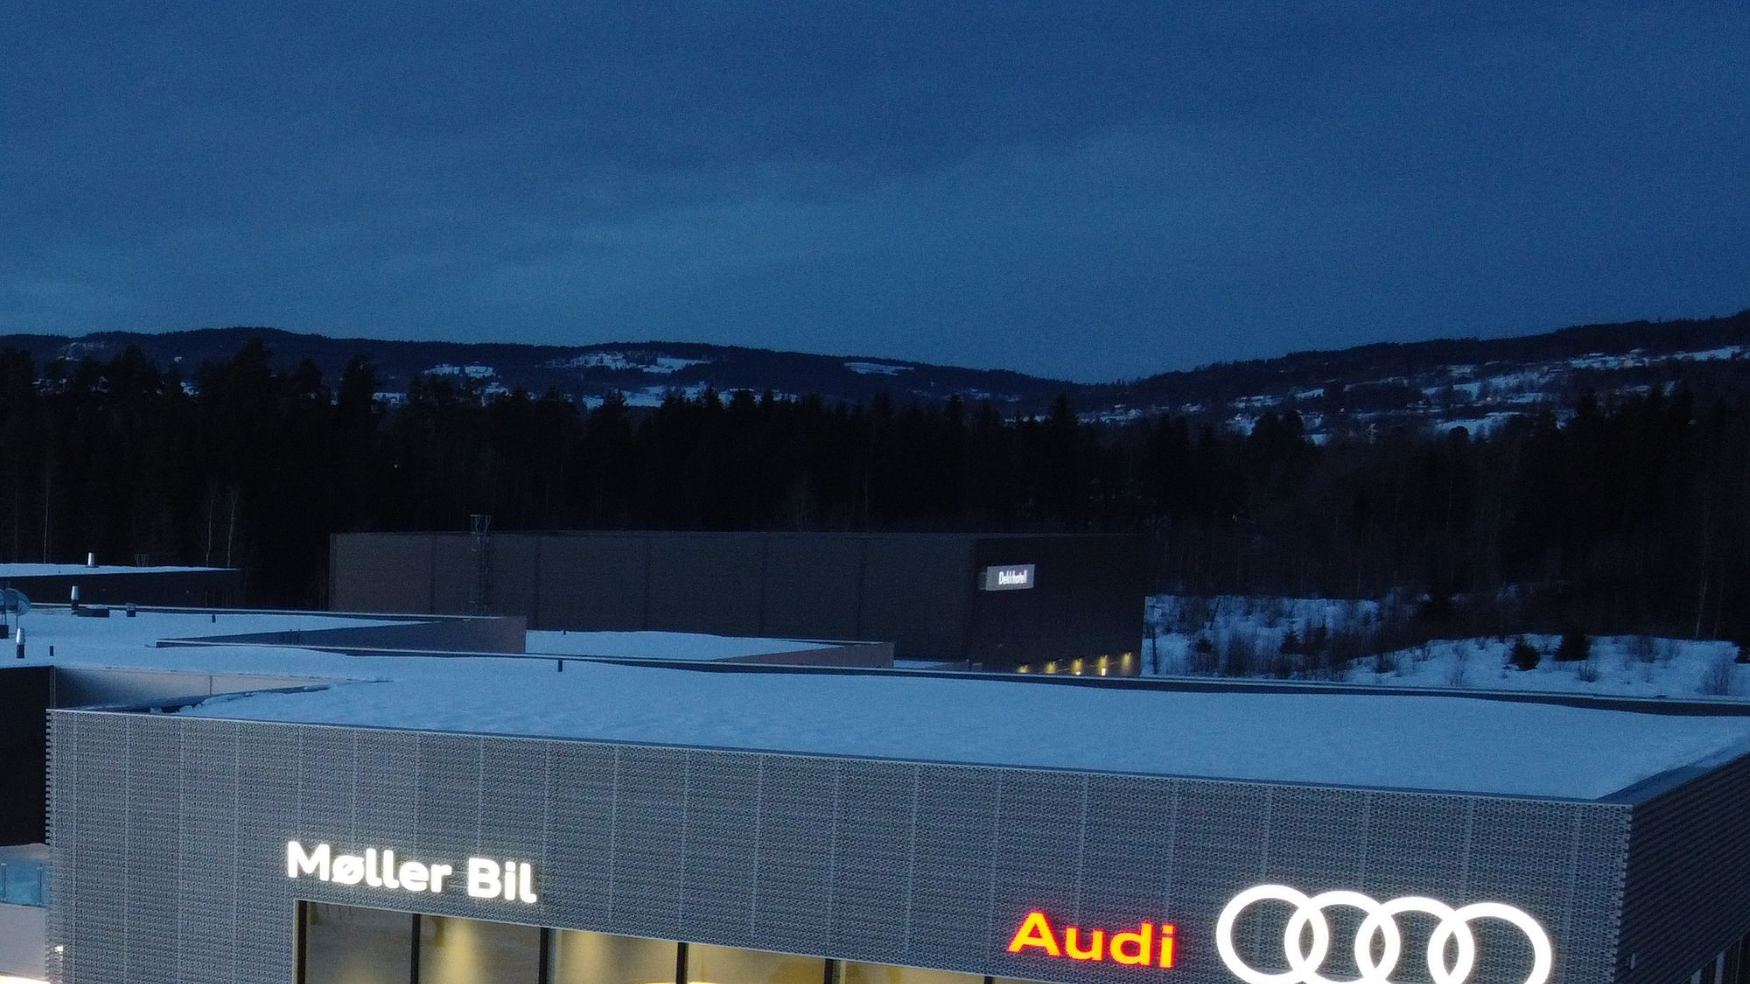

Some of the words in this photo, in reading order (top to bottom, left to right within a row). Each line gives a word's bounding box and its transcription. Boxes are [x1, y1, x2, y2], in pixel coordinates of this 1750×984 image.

[287, 840, 452, 893] Møller
[467, 857, 538, 904] Bil
[1007, 910, 1176, 969] Audi
